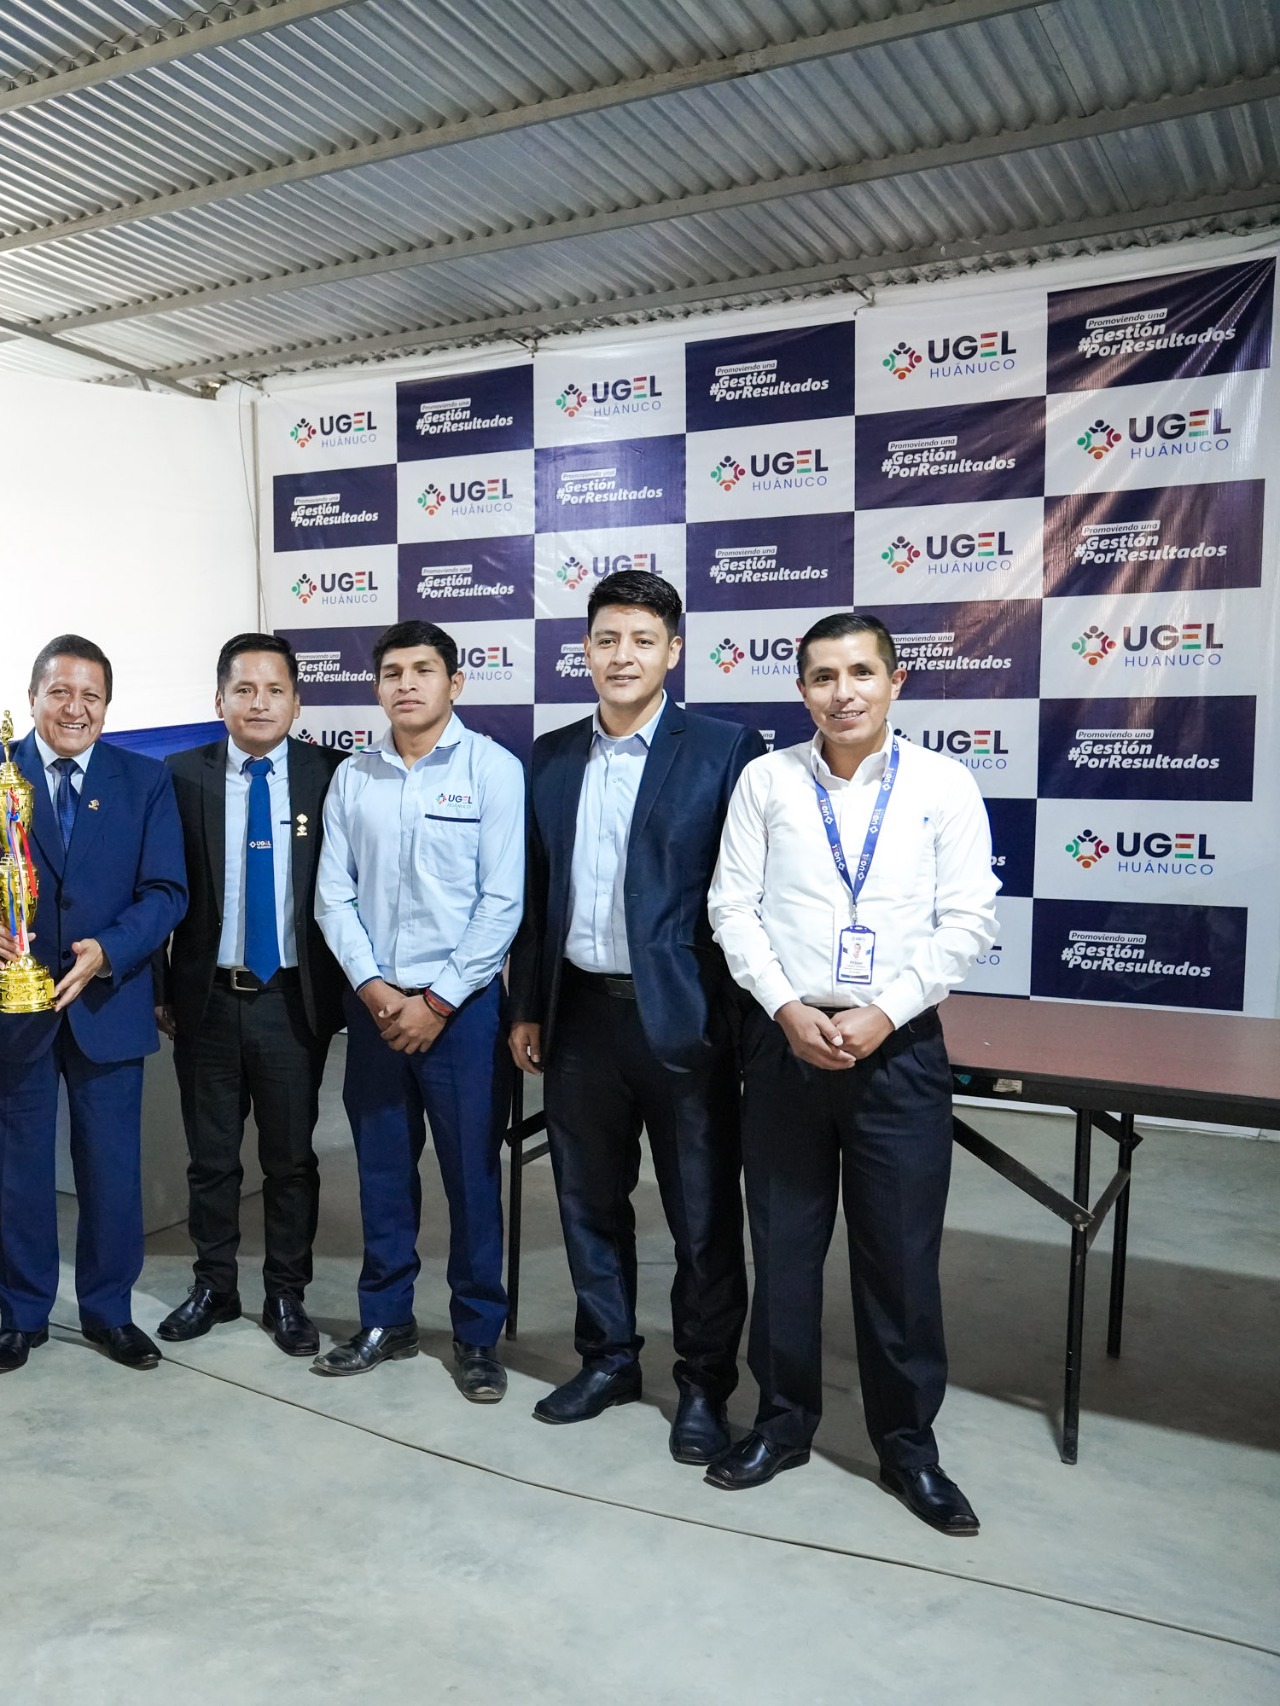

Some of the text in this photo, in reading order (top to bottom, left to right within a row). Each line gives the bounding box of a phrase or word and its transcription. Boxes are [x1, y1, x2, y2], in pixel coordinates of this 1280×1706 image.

[1087, 311, 1165, 327] Promoviendo una
[1078, 321, 1166, 351] #Gestión
[1085, 327, 1236, 359] PorResultados
[928, 331, 1016, 363] UGEL
[717, 362, 776, 374] Promoviendo una
[930, 358, 1015, 379] HUÁNUCO
[592, 375, 662, 403] UGEL
[709, 371, 776, 396] #Gestión
[716, 378, 829, 402] PorResultados
[416, 408, 470, 430] #Gestión
[593, 401, 661, 417] HUÁNUCO
[320, 411, 377, 436] UGEL
[420, 415, 513, 435] PorResultados
[1128, 408, 1231, 443] UGEL
[321, 433, 376, 448] HUÁNUCO
[890, 438, 955, 450] Promoviendo una
[1130, 438, 1230, 460] HUÁNUCO
[750, 449, 828, 477] UGEL
[881, 448, 956, 472] #Gestión
[888, 455, 1016, 479] PorResultados
[450, 478, 513, 503] UGEL
[556, 479, 616, 500] #Gestión
[752, 475, 827, 492] HUÁNUCO
[561, 486, 663, 506] PorResultados
[290, 503, 340, 522] #Gestión
[294, 509, 378, 527] PorResultados
[451, 502, 513, 517] HUÁNUCO
[1083, 522, 1158, 535] Promoviendo una
[717, 547, 775, 558] Promoviendo una
[926, 531, 1013, 560] UGEL
[1074, 532, 1159, 559] #Gestión
[1081, 542, 1227, 565] PorResultados
[709, 557, 776, 577] #Gestión
[715, 566, 828, 584] PorResultados
[928, 559, 1012, 576] HUÁNUCO
[320, 571, 378, 593] UGEL
[417, 574, 472, 593] #Gestión
[422, 582, 515, 599] PorResultados
[322, 593, 378, 605] HUÁNUCO
[892, 635, 935, 643] romoviendo
[1123, 623, 1223, 651] UGEL
[750, 638, 802, 661] UG
[1125, 651, 1221, 667] HUÁNUCO
[298, 660, 340, 672] Gestión
[752, 662, 799, 675] HUÁNU
[898, 655, 1012, 671] orResultados
[464, 670, 512, 680] ÁNUCO
[923, 730, 1008, 754] UGEL
[1077, 730, 1152, 739] Promoviendo una
[1068, 740, 1152, 763] #Gestión
[1075, 753, 1220, 770] PorResultados
[448, 794, 472, 804] UGEL
[1116, 831, 1215, 860] UGEL
[1118, 859, 1214, 875] HUÁNUCO
[1071, 931, 1144, 943] Promoviendo una
[1061, 942, 1145, 961] #Gestión
[1068, 955, 1211, 978] PorResultados
